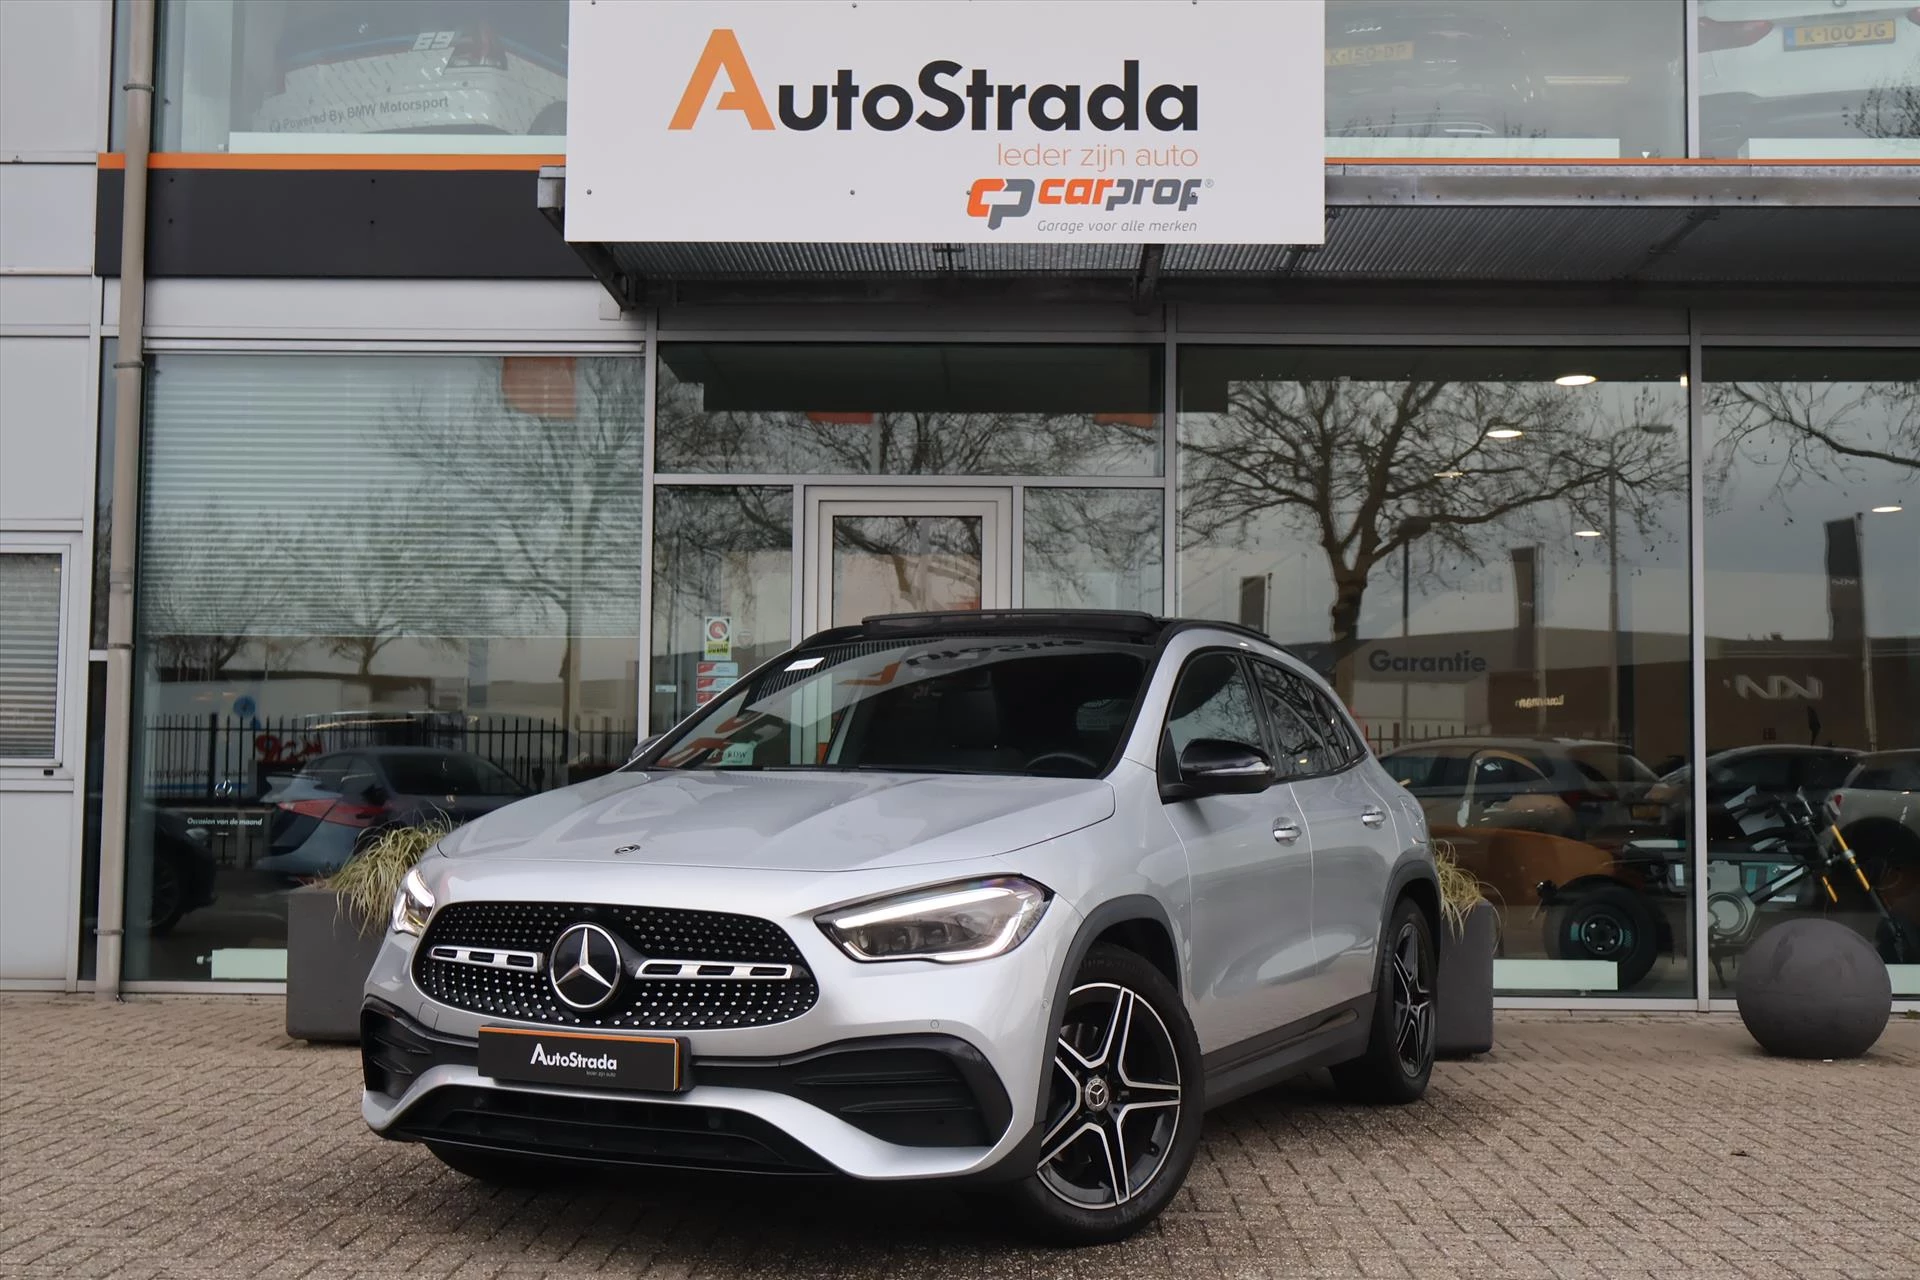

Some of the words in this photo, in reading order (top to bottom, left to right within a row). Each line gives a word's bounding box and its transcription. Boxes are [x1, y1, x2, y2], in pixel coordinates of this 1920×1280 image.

[412, 31, 456, 50] 69
[1803, 23, 1887, 42] K-100-JG
[667, 28, 1198, 132] AutoStrada
[282, 110, 327, 131] Powered
[328, 109, 345, 123] By
[347, 105, 377, 119] BMW
[379, 96, 450, 114] Motorsport
[997, 143, 1072, 167] Ieder
[1080, 144, 1125, 172] zijn
[1135, 144, 1199, 167] auto
[1037, 220, 1084, 234] Garage
[1088, 222, 1117, 232] voor
[1120, 220, 1145, 232] alle
[1148, 220, 1198, 232] merken
[1367, 649, 1487, 673] Garantie
[216, 818, 229, 826] van
[229, 817, 239, 826] de
[239, 817, 263, 826] maand
[530, 1042, 617, 1071] AutoStrada
